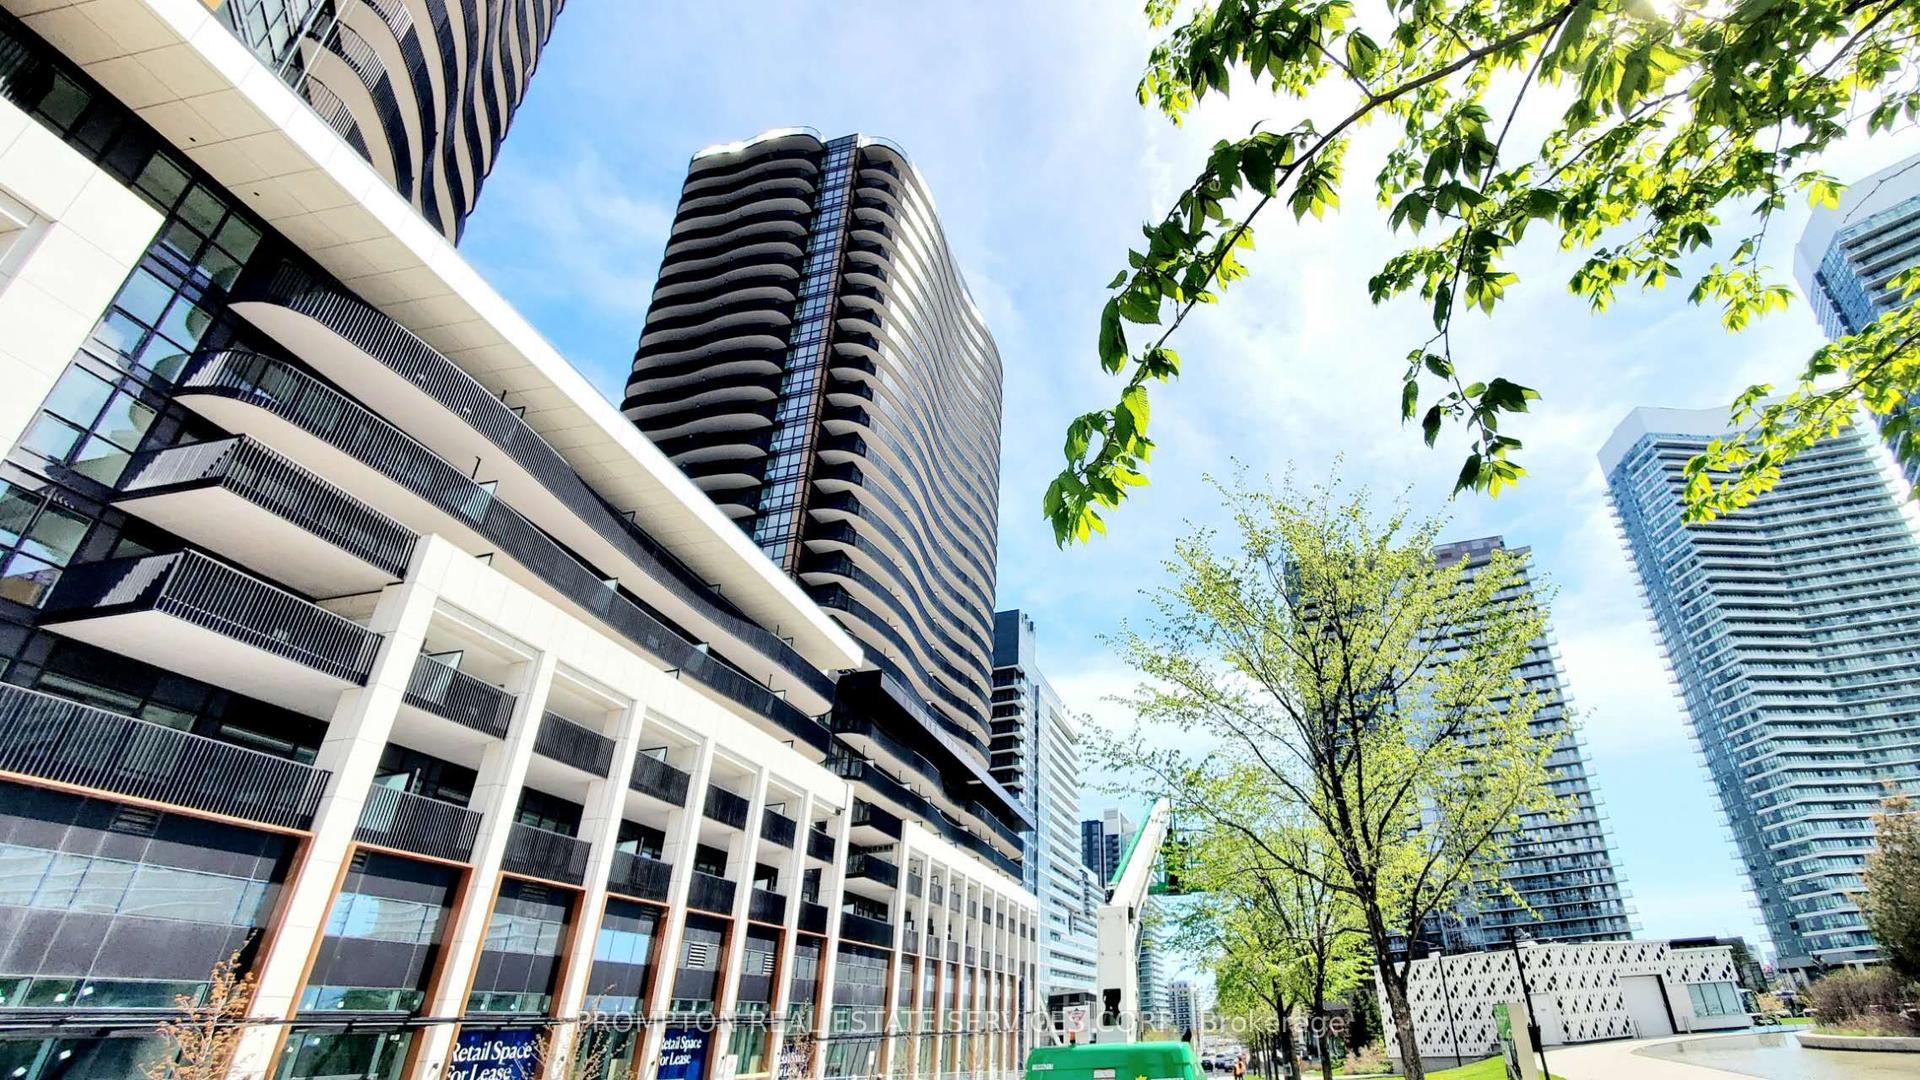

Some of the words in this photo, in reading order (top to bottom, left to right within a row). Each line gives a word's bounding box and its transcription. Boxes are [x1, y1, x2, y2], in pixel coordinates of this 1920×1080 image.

[491, 1041, 532, 1065] Space
[680, 1035, 703, 1053] Space
[669, 1052, 692, 1065] Lease
